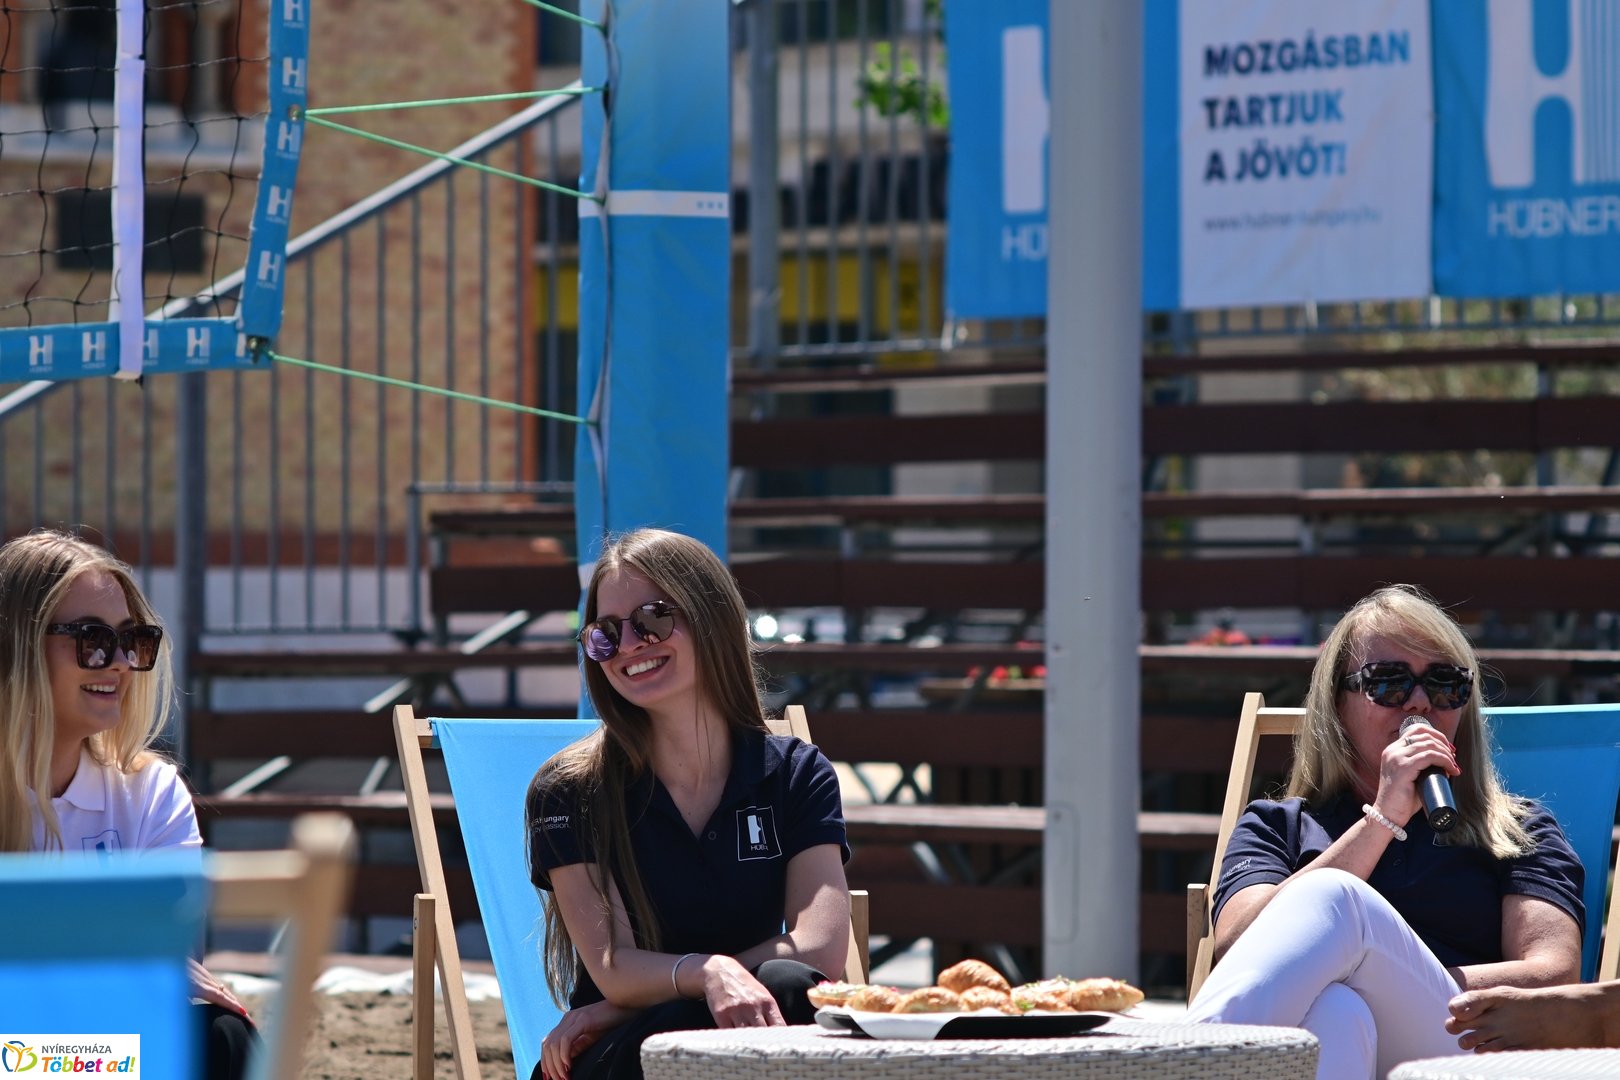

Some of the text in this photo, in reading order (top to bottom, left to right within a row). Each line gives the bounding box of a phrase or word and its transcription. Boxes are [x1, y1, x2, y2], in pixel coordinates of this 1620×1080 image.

[1203, 29, 1410, 78] MOZGÁSBAN
[1203, 89, 1345, 130] TARTJUK
[1205, 150, 1227, 181] A
